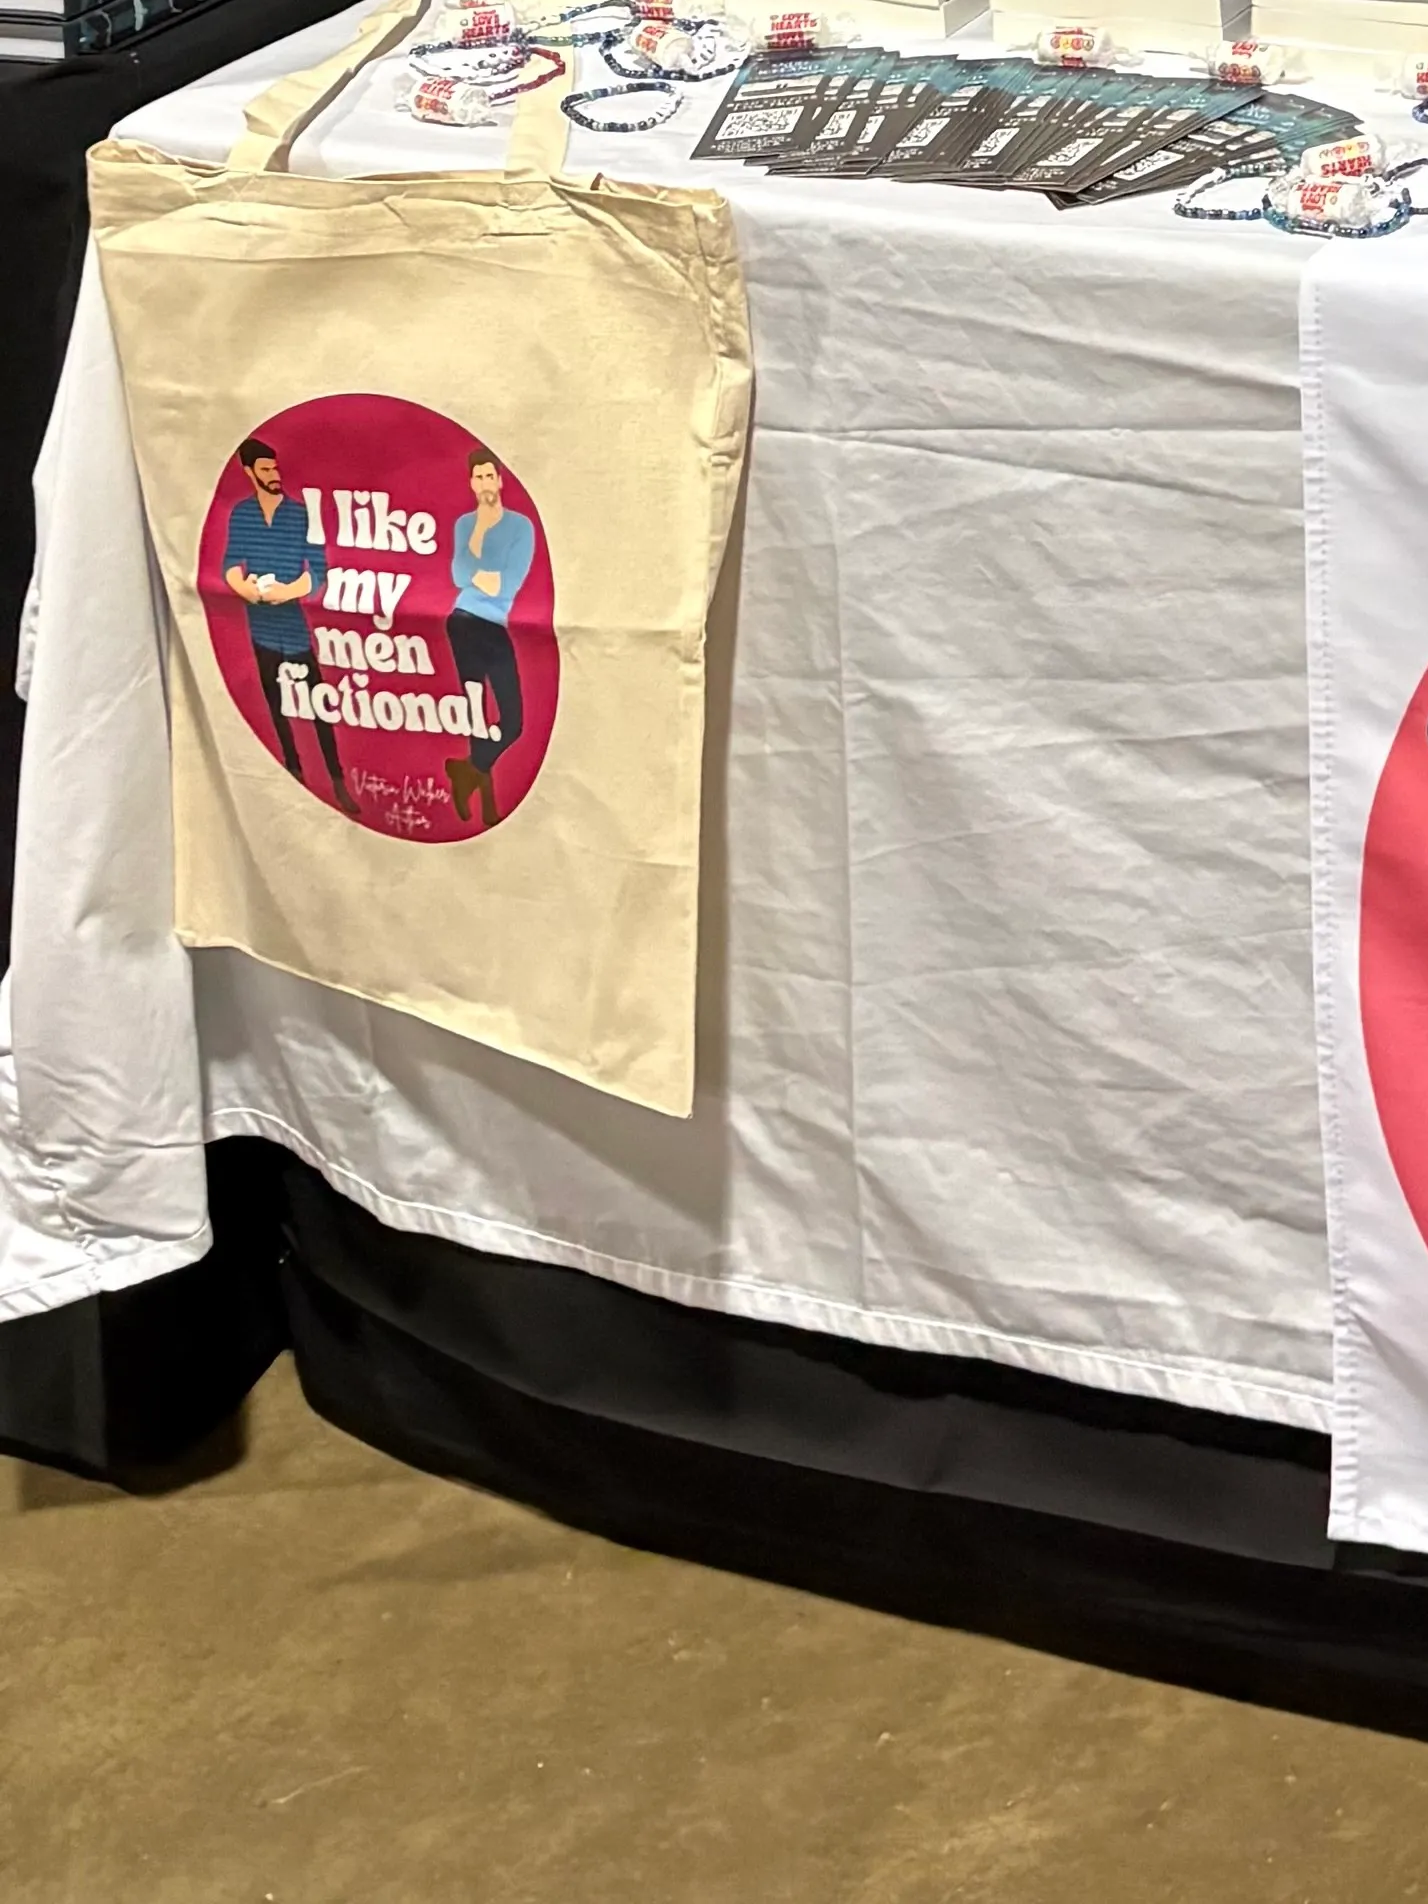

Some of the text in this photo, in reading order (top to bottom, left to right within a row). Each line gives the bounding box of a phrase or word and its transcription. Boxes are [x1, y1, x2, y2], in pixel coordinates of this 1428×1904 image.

[302, 488, 437, 555] I like
[324, 566, 411, 629] my
[315, 625, 435, 676] men
[276, 661, 502, 742] fictional.
